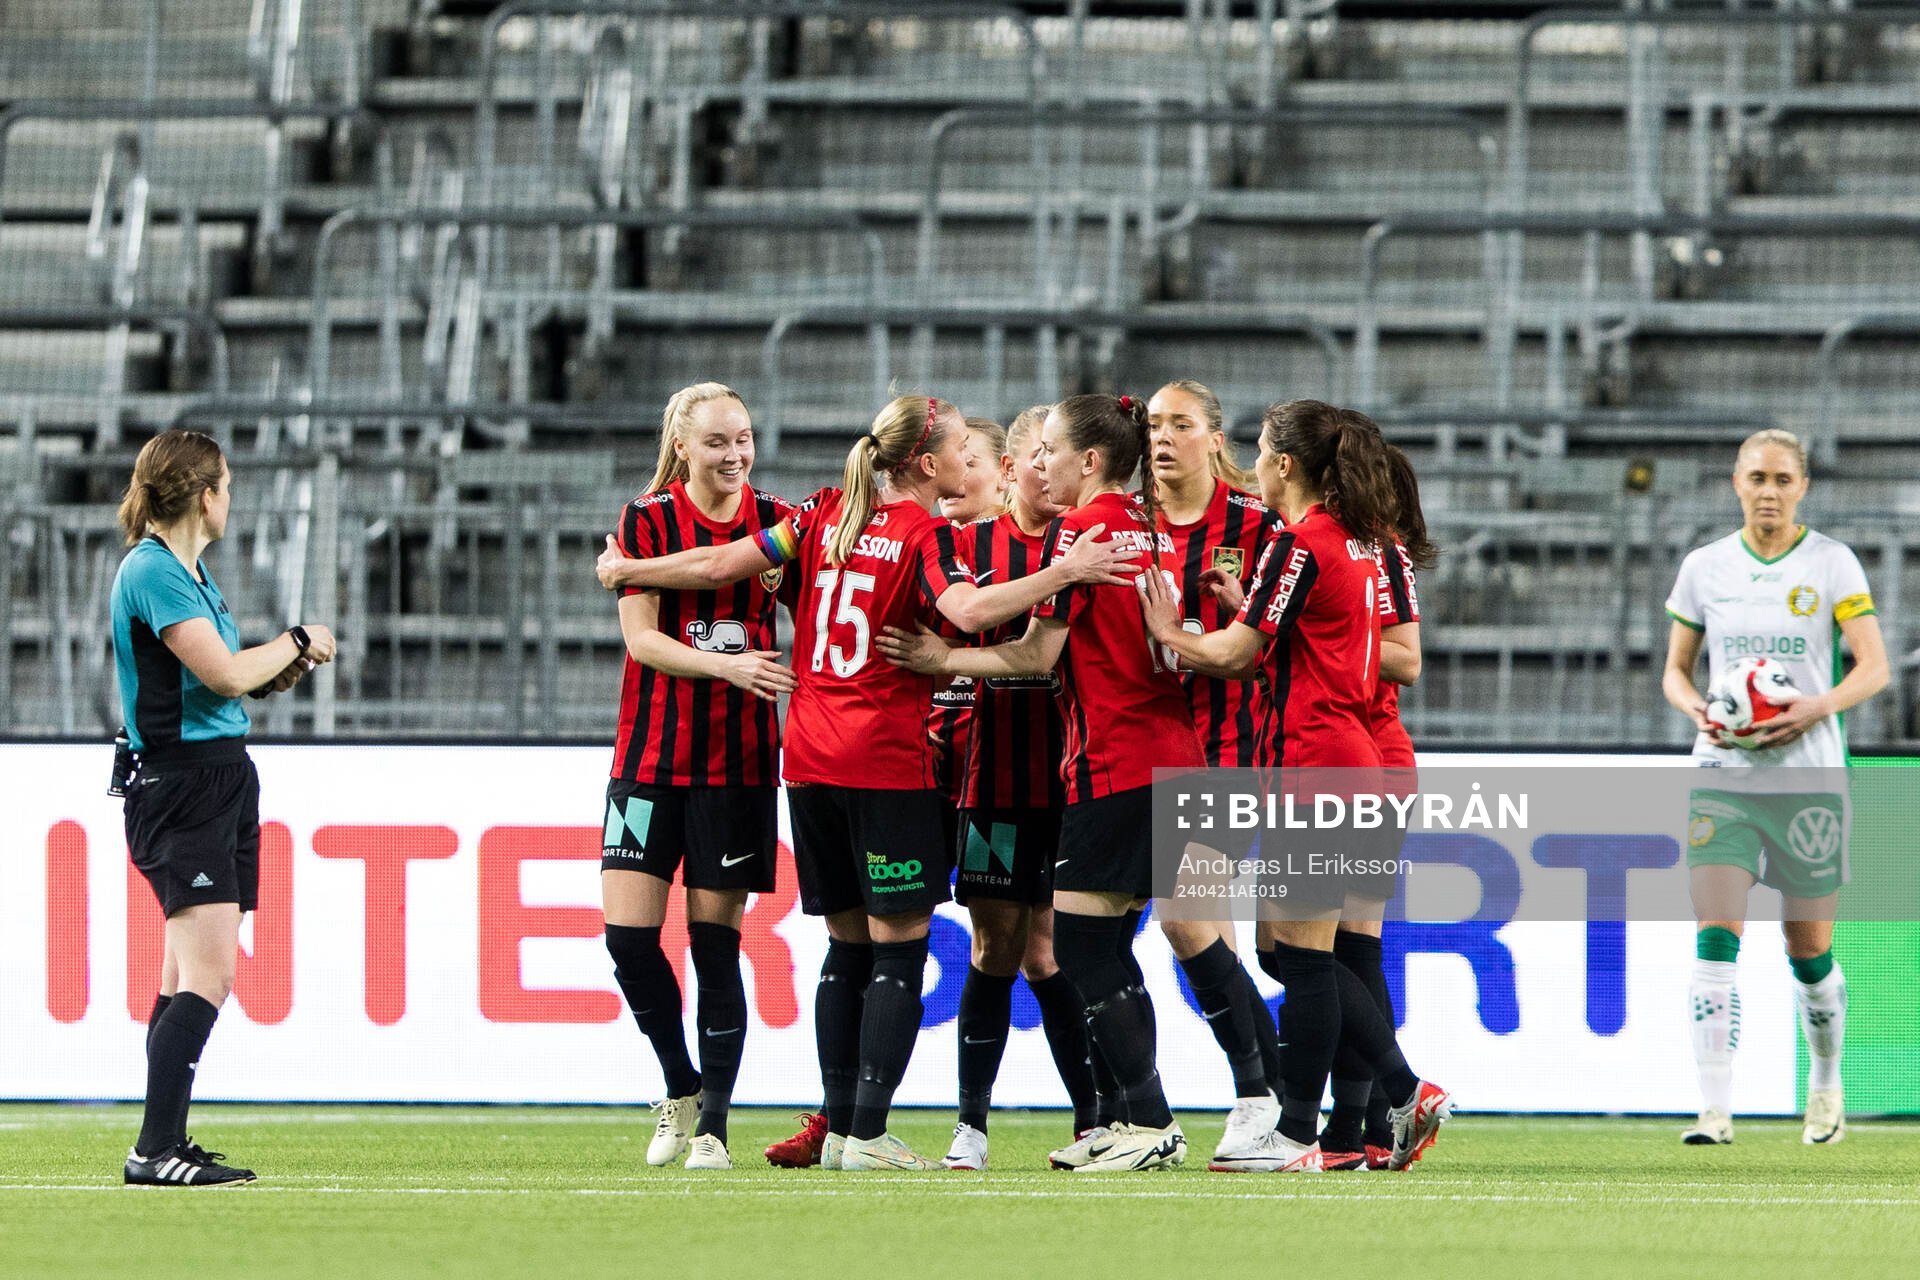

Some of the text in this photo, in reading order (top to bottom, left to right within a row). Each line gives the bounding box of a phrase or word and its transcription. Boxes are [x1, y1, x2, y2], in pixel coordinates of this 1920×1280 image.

[1266, 546, 1309, 625] stadium
[814, 568, 876, 678] 15
[1723, 635, 1806, 655] PROJOB
[867, 860, 922, 880] coop
[962, 873, 1012, 886] NORTEAM
